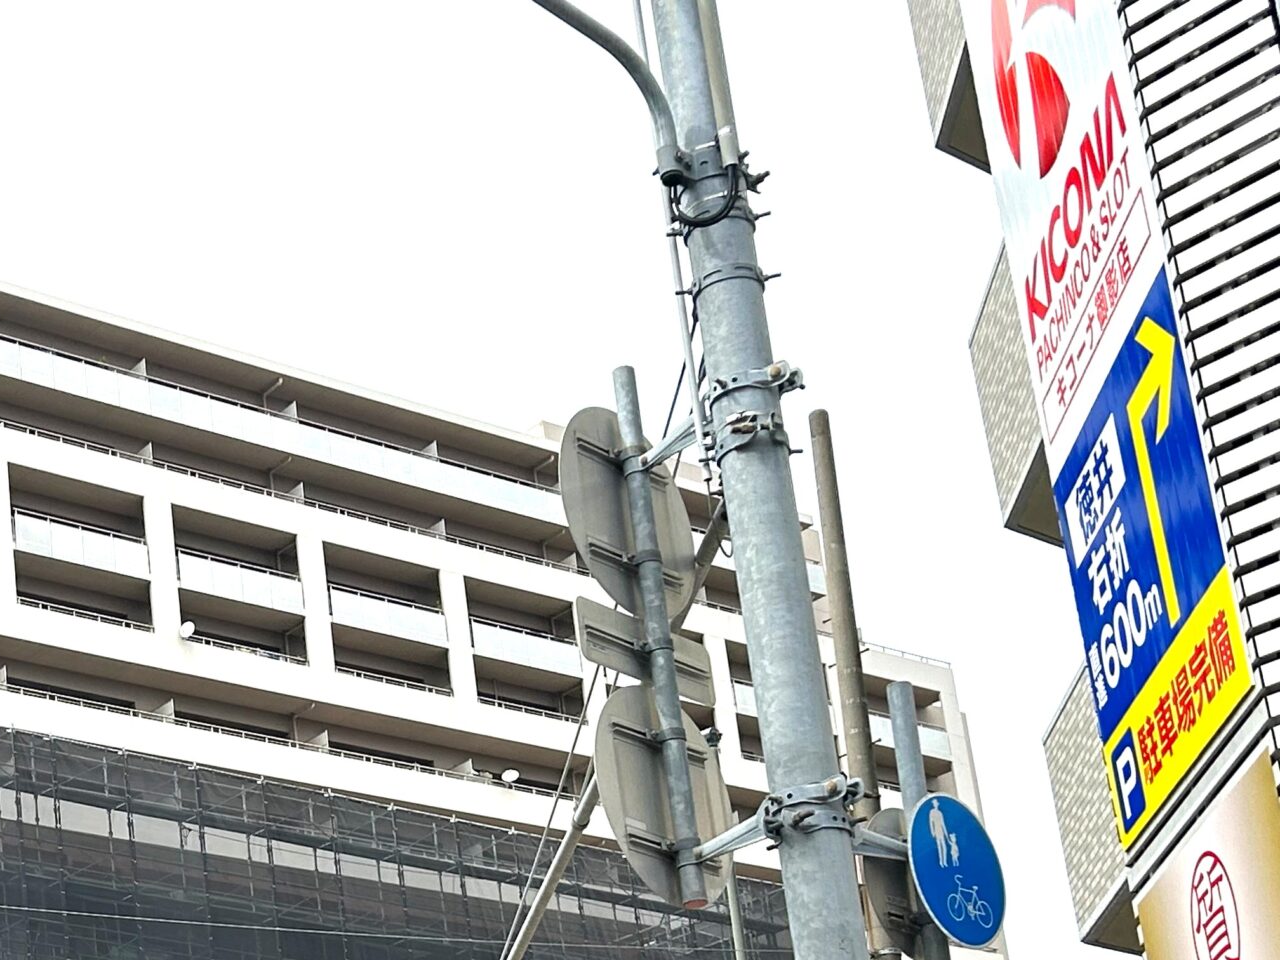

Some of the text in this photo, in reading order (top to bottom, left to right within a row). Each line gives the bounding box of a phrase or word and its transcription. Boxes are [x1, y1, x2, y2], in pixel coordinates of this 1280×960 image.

[1025, 71, 1127, 344] KICONA
[1087, 506, 1130, 615] 右折
[1100, 578, 1163, 689] 600m
[1137, 608, 1236, 785] 駐車場完備
[1116, 745, 1137, 820] P
